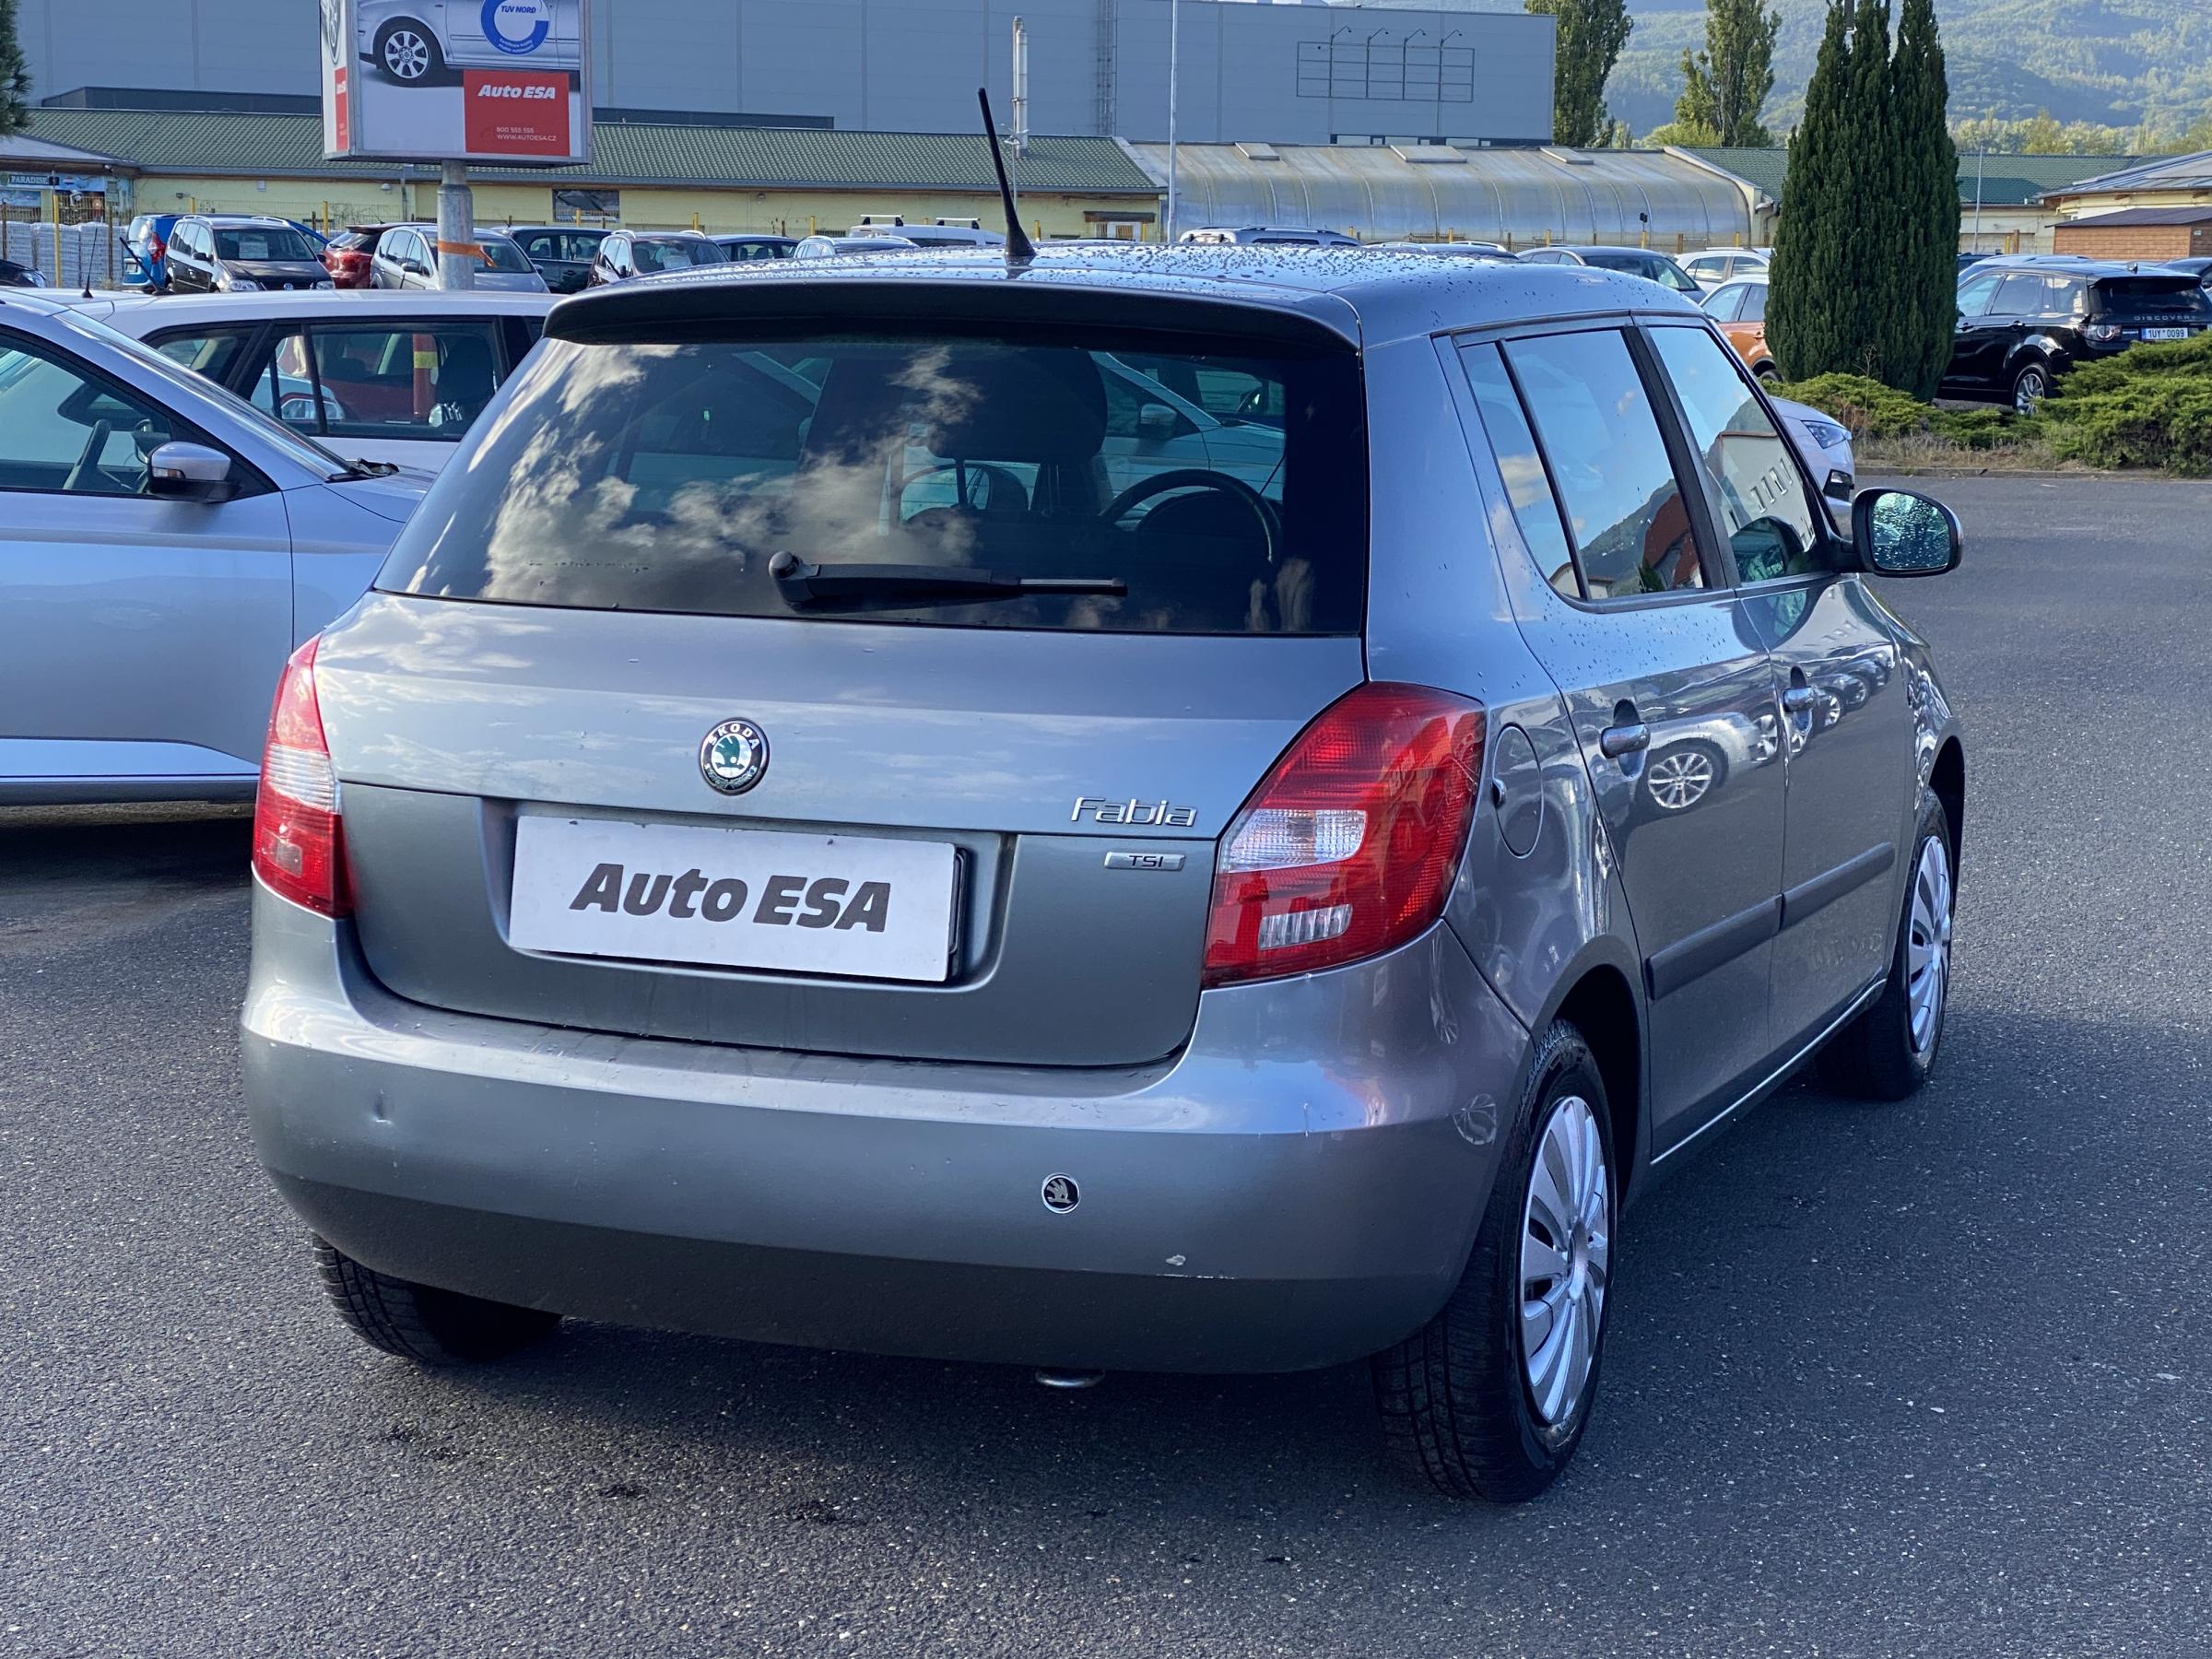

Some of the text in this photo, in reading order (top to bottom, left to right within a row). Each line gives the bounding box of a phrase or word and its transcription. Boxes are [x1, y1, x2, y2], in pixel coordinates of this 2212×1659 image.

[515, 6, 536, 14] NORD
[477, 85, 556, 99] Auto ESA
[496, 134, 557, 142] WWW.AUTOESA.CZ
[2148, 329, 2161, 337] 1UY
[2167, 329, 2184, 337] 0099
[1071, 796, 1197, 828] Fabia
[1128, 854, 1163, 868] TSI
[569, 863, 891, 933] Auto ESA
